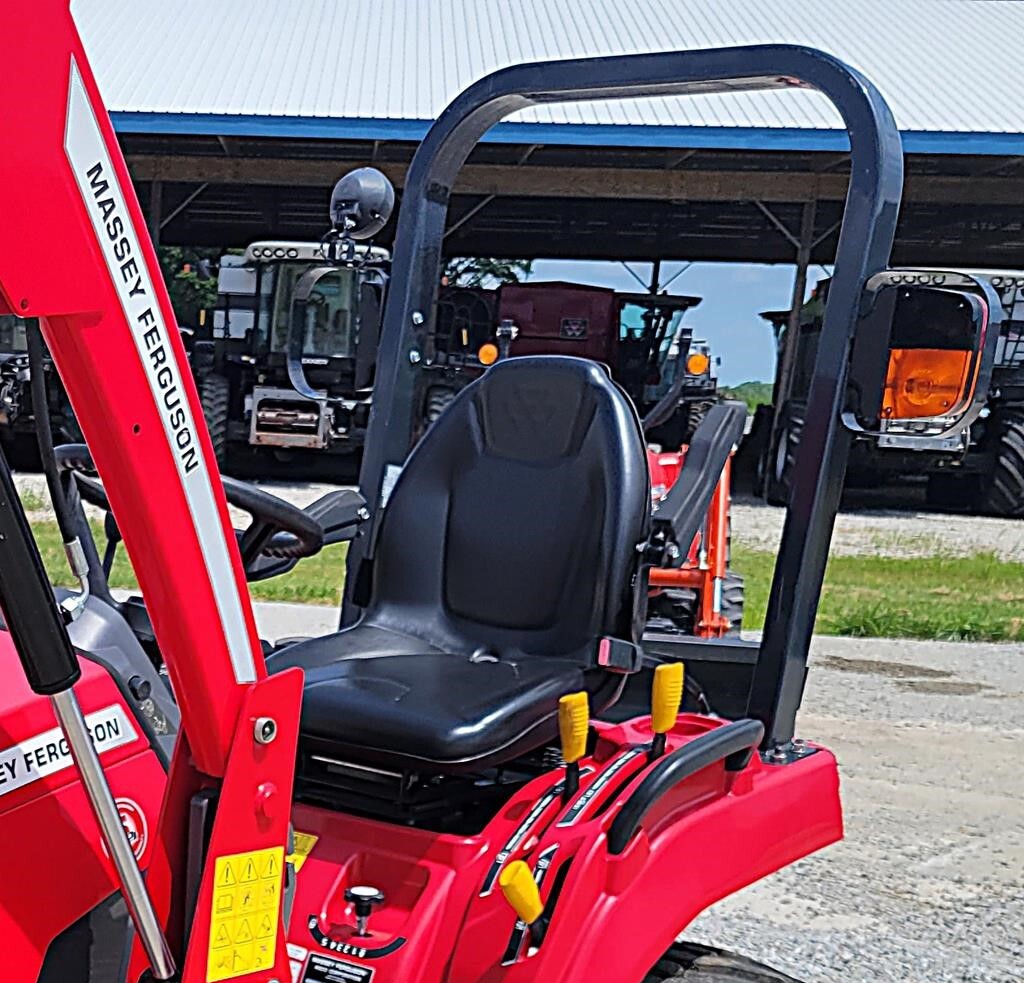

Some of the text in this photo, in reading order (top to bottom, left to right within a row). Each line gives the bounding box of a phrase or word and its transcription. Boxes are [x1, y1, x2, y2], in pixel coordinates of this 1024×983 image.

[86, 161, 199, 474] MASSEY FERGUSON
[23, 718, 121, 773] FERGON
